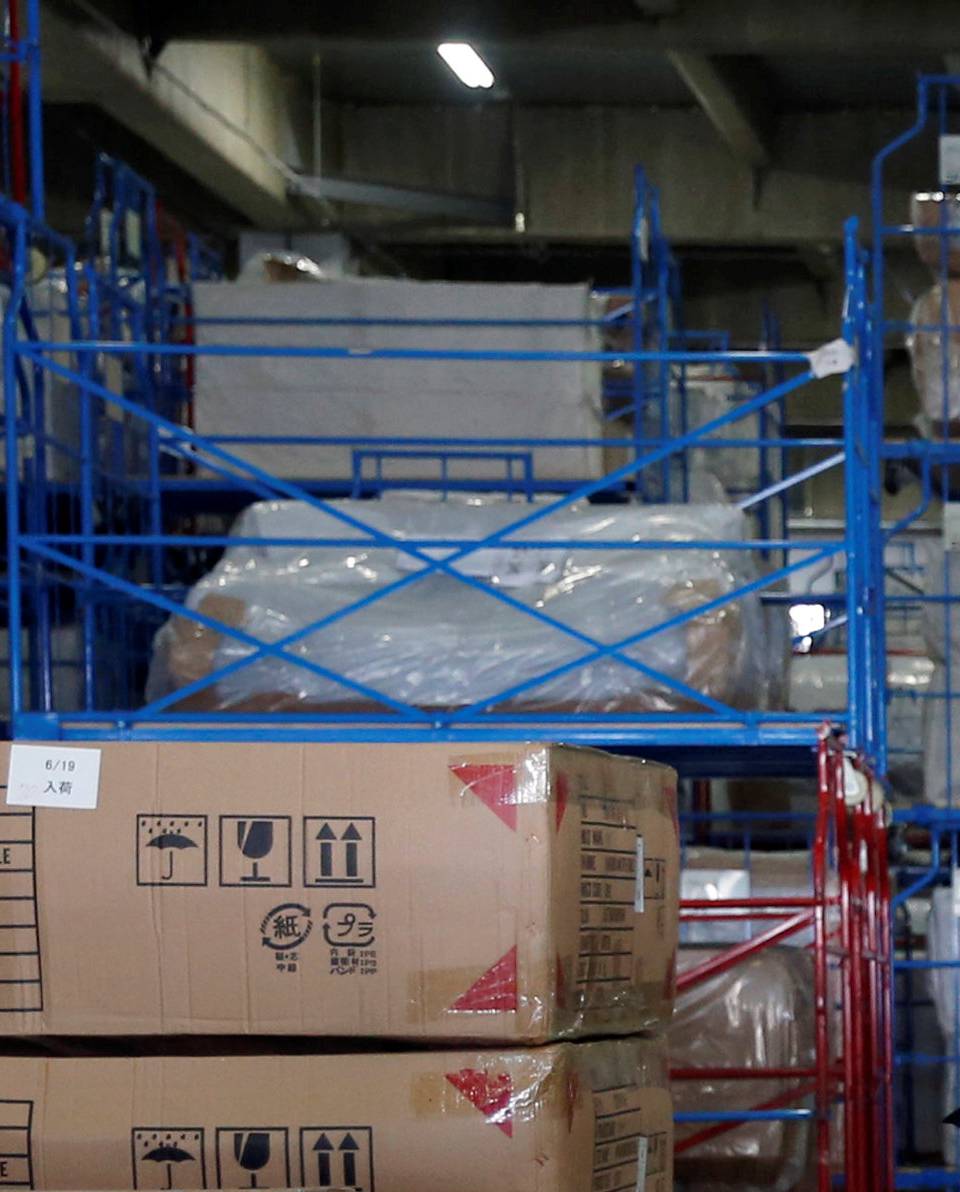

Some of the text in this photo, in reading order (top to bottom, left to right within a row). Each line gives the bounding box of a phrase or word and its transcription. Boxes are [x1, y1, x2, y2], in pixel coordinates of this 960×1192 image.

[45, 760, 76, 772] 6/19
[43, 780, 73, 795] 入荷
[0, 847, 11, 864] E
[273, 915, 302, 939] 紙
[337, 913, 374, 937] プラ
